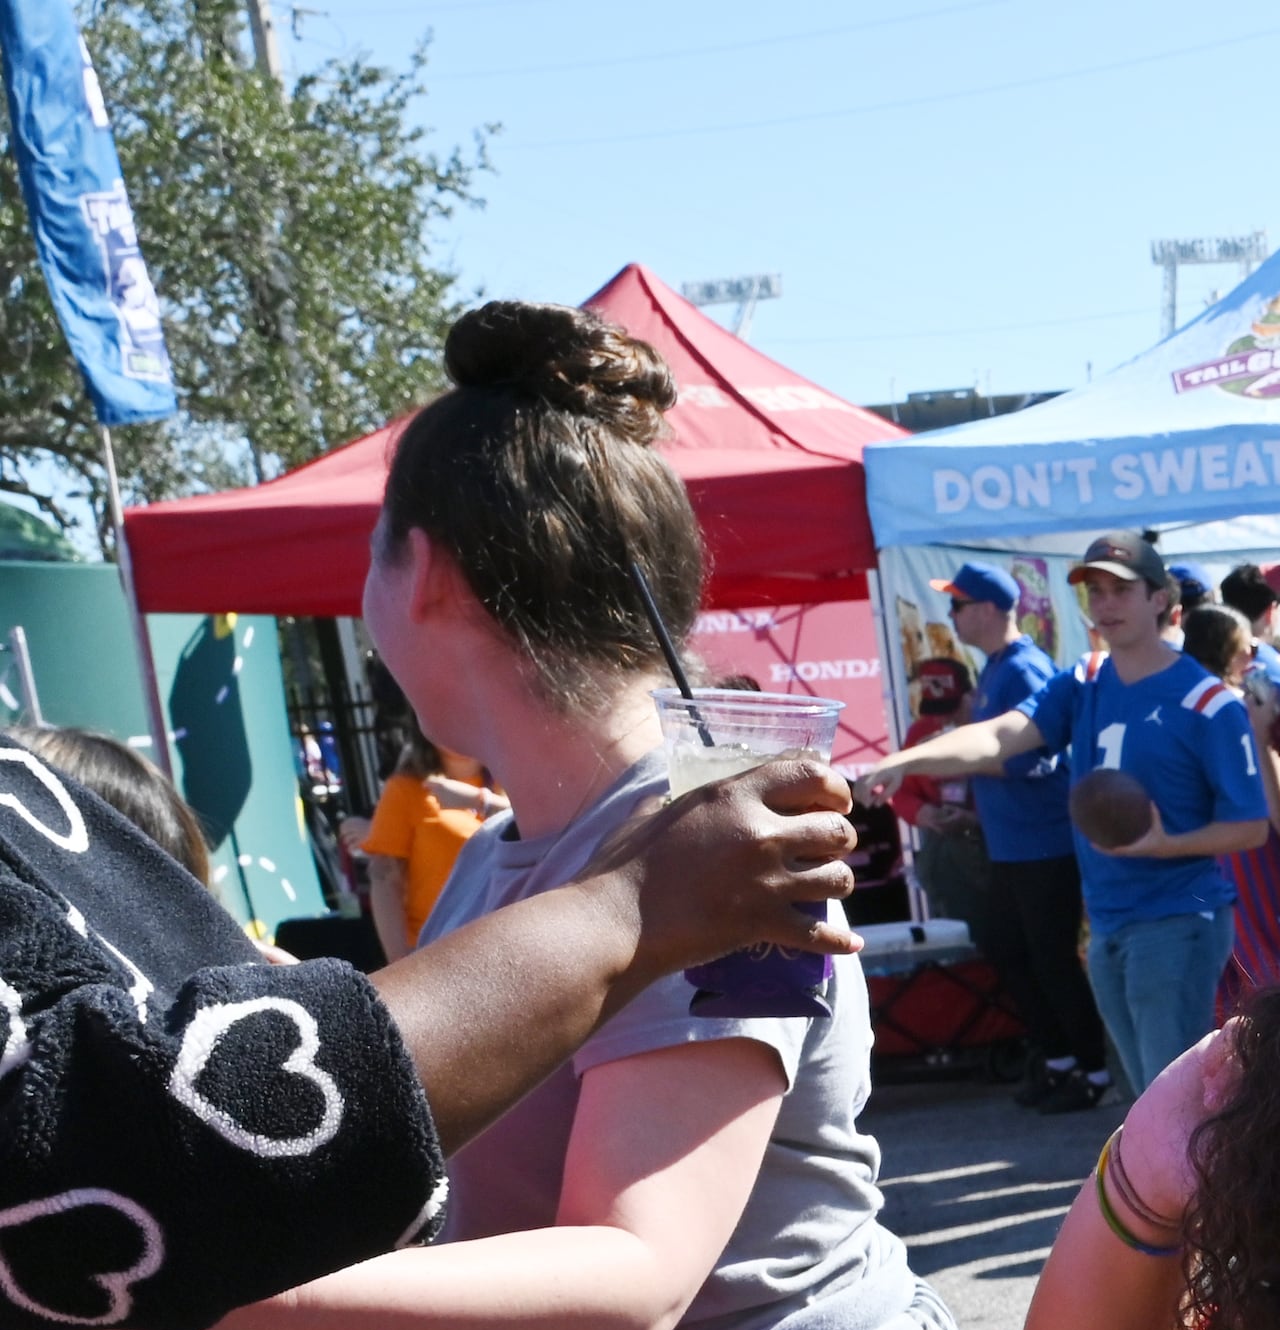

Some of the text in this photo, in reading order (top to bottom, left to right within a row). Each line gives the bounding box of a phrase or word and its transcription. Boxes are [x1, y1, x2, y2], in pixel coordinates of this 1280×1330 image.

[932, 456, 1098, 514] DON'T
[770, 658, 882, 683] HONDA
[1240, 733, 1258, 777] 1
